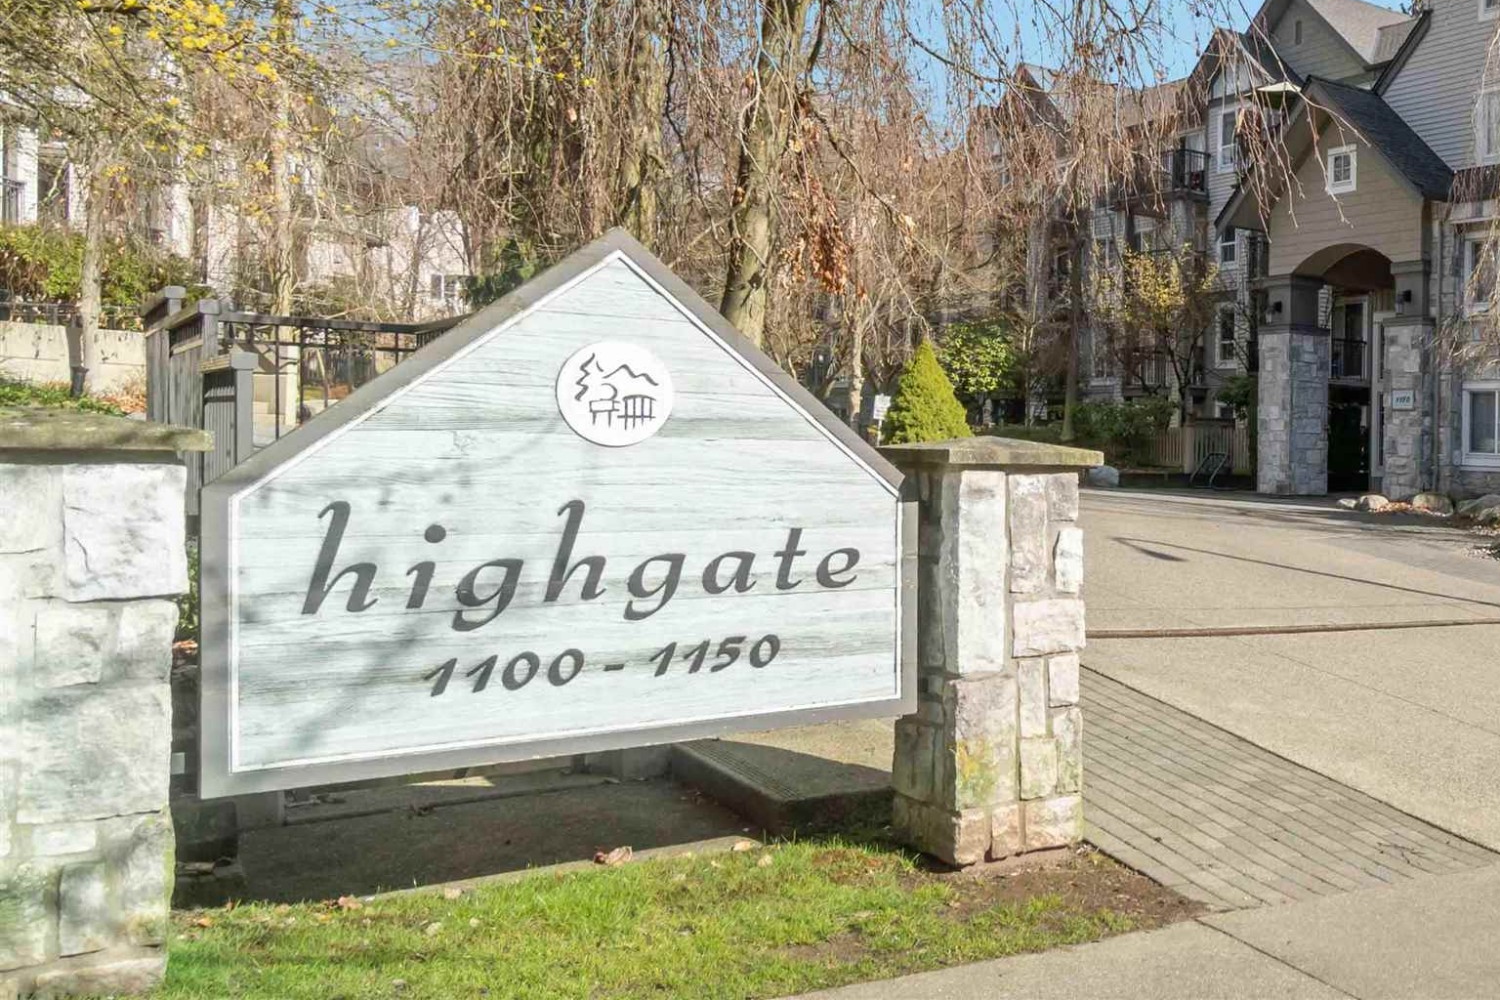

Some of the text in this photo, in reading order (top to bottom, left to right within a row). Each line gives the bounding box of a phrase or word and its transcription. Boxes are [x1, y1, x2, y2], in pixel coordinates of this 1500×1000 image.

[302, 500, 860, 632] highgate
[422, 648, 585, 697] 1100
[648, 634, 781, 677] 1150
